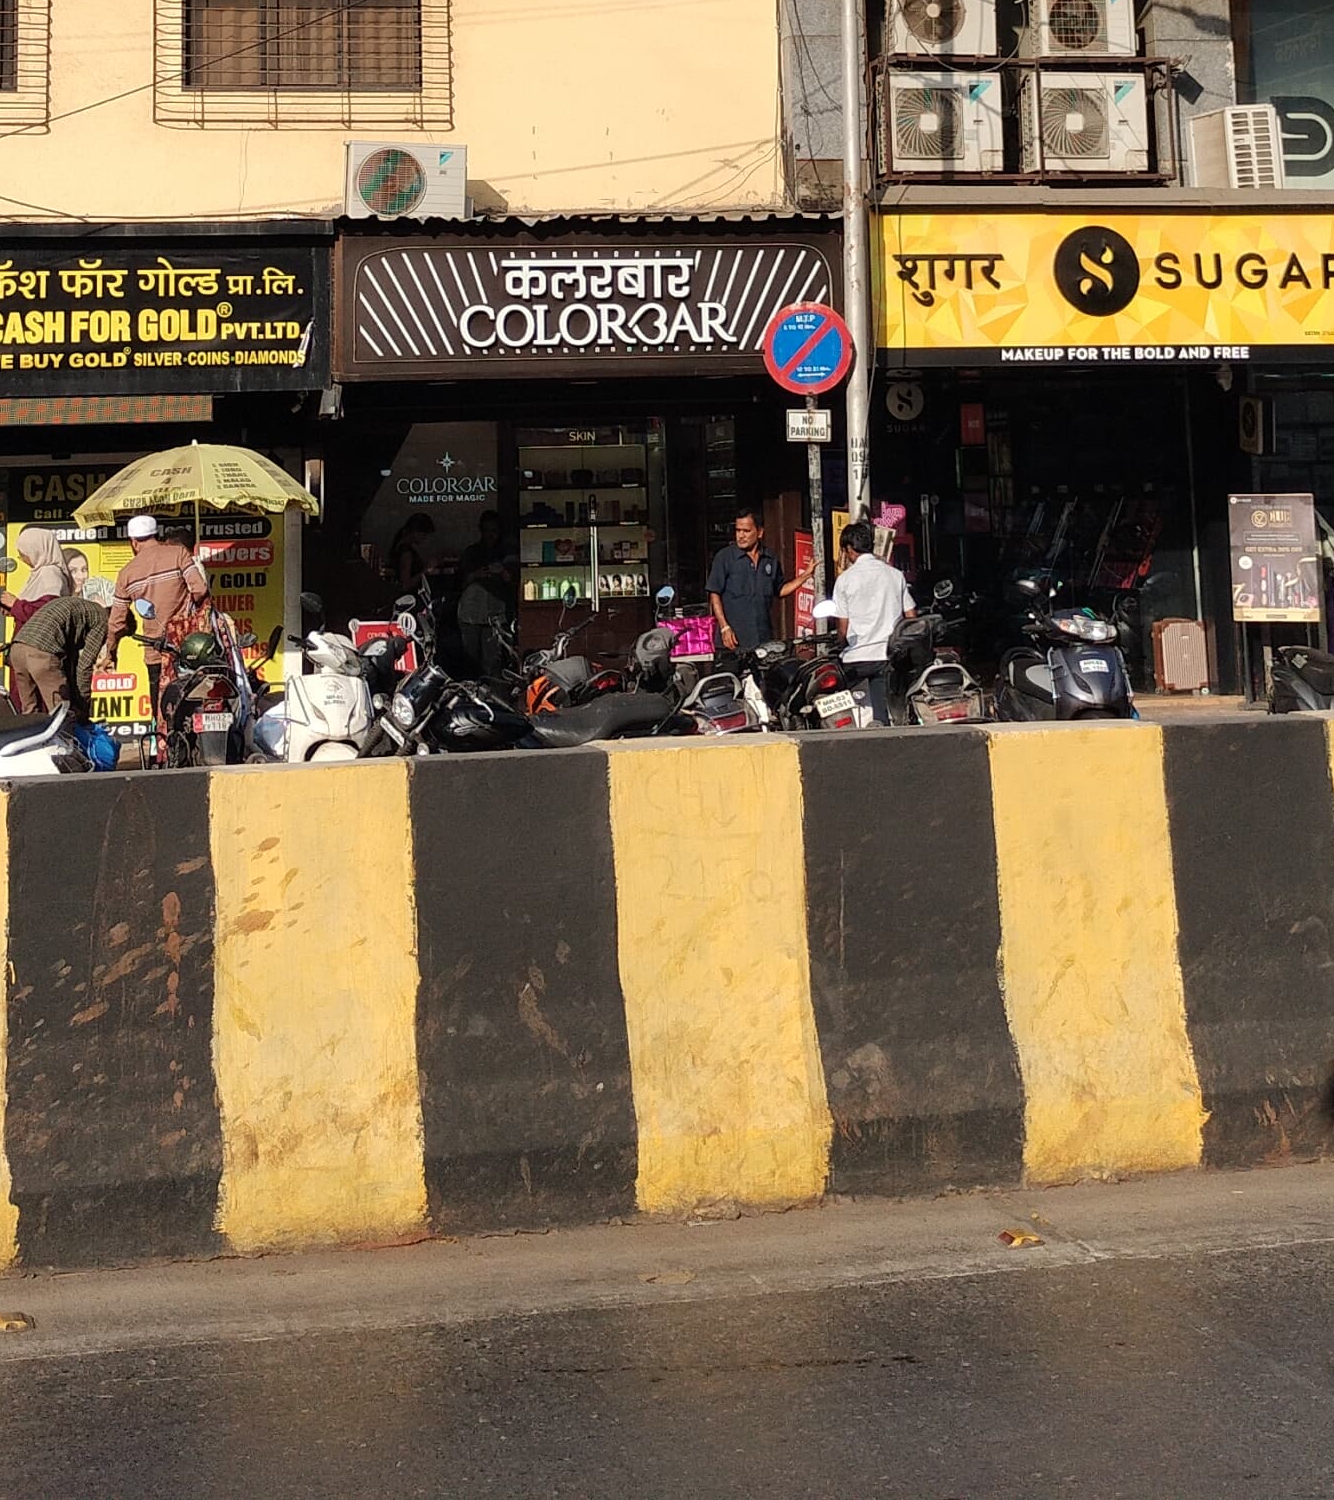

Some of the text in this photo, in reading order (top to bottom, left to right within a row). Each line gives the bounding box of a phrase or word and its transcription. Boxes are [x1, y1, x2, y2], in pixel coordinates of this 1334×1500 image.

[59, 258, 129, 298] फॉर
[137, 257, 222, 298] गोल्ड
[501, 259, 693, 298] कलरबार
[893, 254, 1004, 305] शुगर
[71, 311, 130, 344] FOR
[138, 308, 216, 342] GOLD
[460, 302, 737, 347] COLORBAR
[20, 354, 63, 369] BUY
[69, 353, 124, 367] GOLD
[1001, 346, 1249, 361] MAKEUP FOR THE BOLD AND FREE
[802, 417, 814, 425] NO
[569, 431, 596, 442] SKIN
[790, 426, 825, 437] PARKING
[23, 474, 105, 502] CASH
[396, 476, 497, 494] COLORBAR
[409, 495, 435, 503] MADE
[456, 494, 485, 502] MAGIC
[52, 526, 108, 540] arded
[200, 546, 271, 564] Buyers
[220, 572, 267, 588] GOLD
[97, 677, 134, 690] GOLD
[92, 695, 134, 718] TANT
